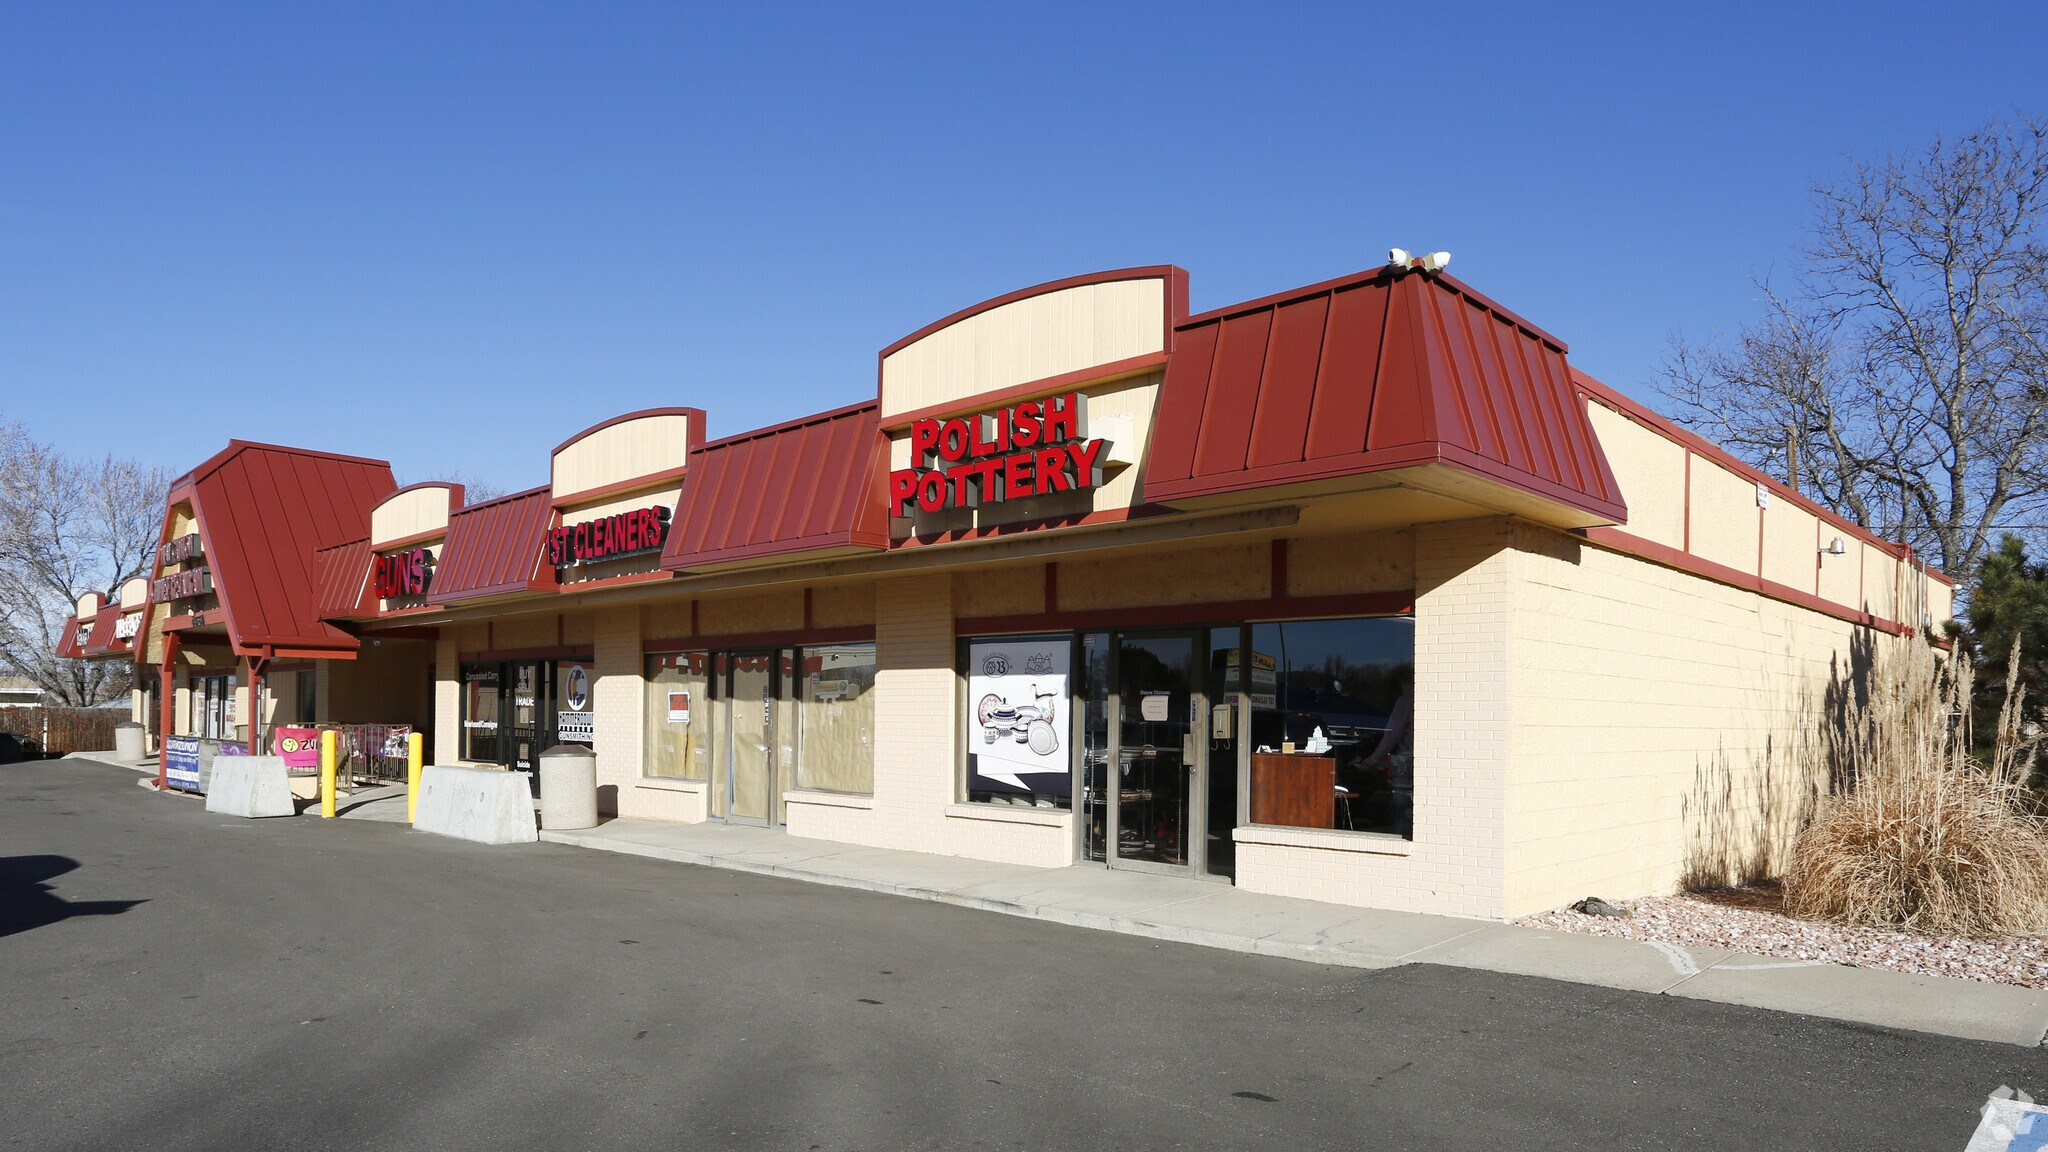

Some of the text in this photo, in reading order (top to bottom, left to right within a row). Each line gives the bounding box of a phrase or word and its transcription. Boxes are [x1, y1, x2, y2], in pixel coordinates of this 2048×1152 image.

[911, 392, 1077, 469] POLISH
[889, 438, 1106, 519] POTTERY
[574, 504, 662, 559] CLEANERS
[374, 547, 426, 600] GUNS
[515, 696, 534, 707] TRADE
[300, 739, 318, 751] ZU
